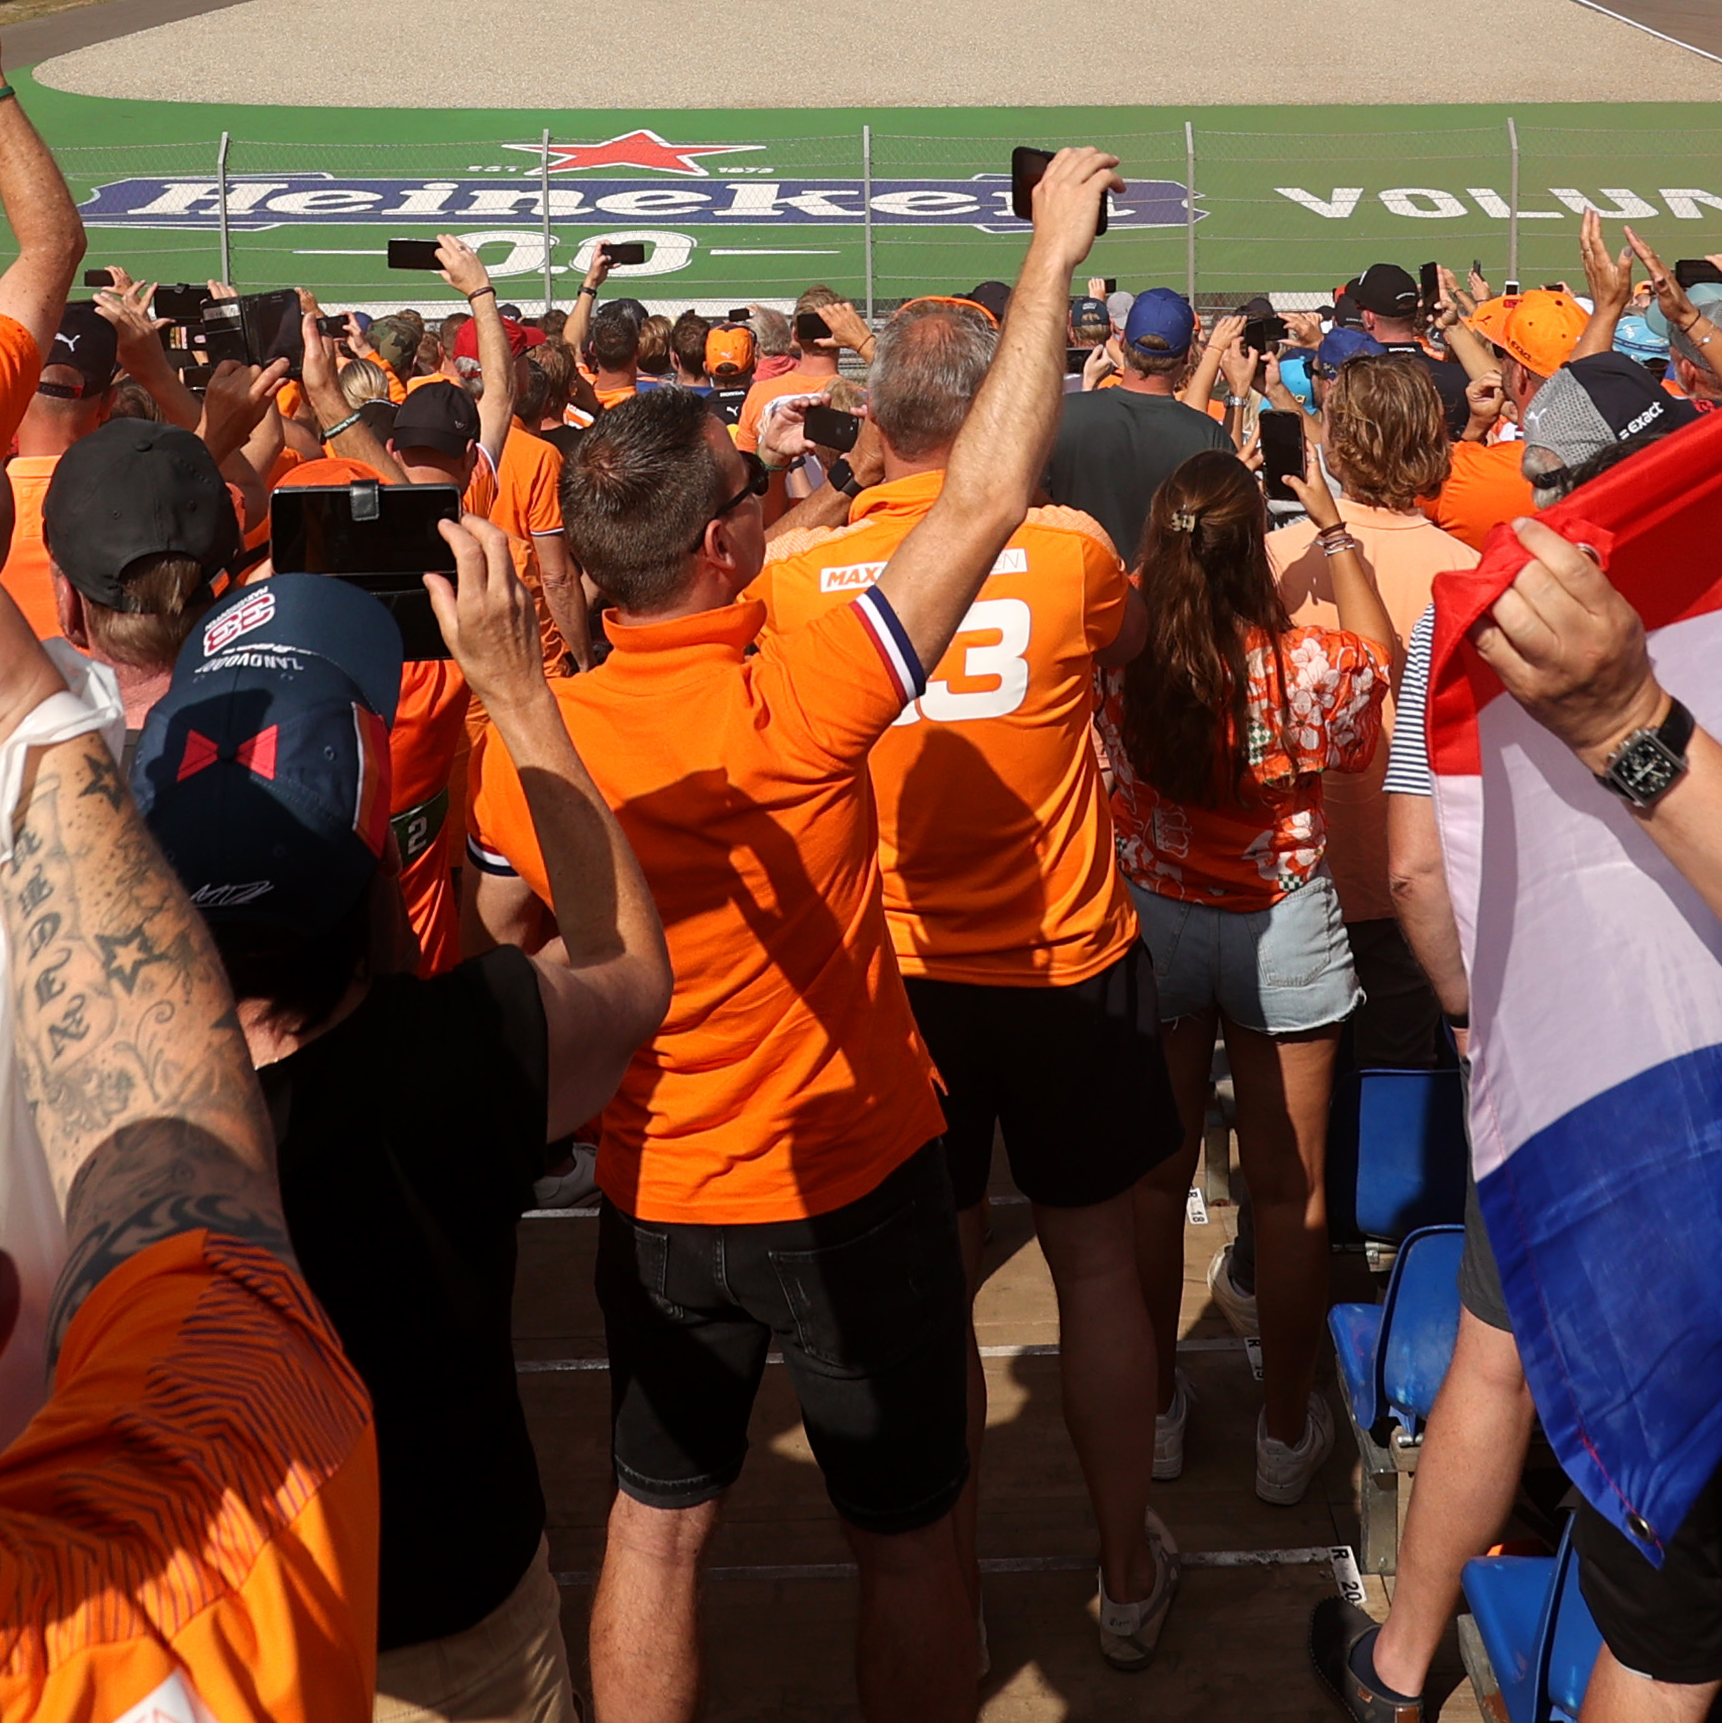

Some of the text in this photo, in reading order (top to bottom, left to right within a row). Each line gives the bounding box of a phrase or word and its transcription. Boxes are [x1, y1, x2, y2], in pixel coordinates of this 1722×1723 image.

[891, 597, 1032, 726] 3
[1330, 1548, 1364, 1603] R 20
